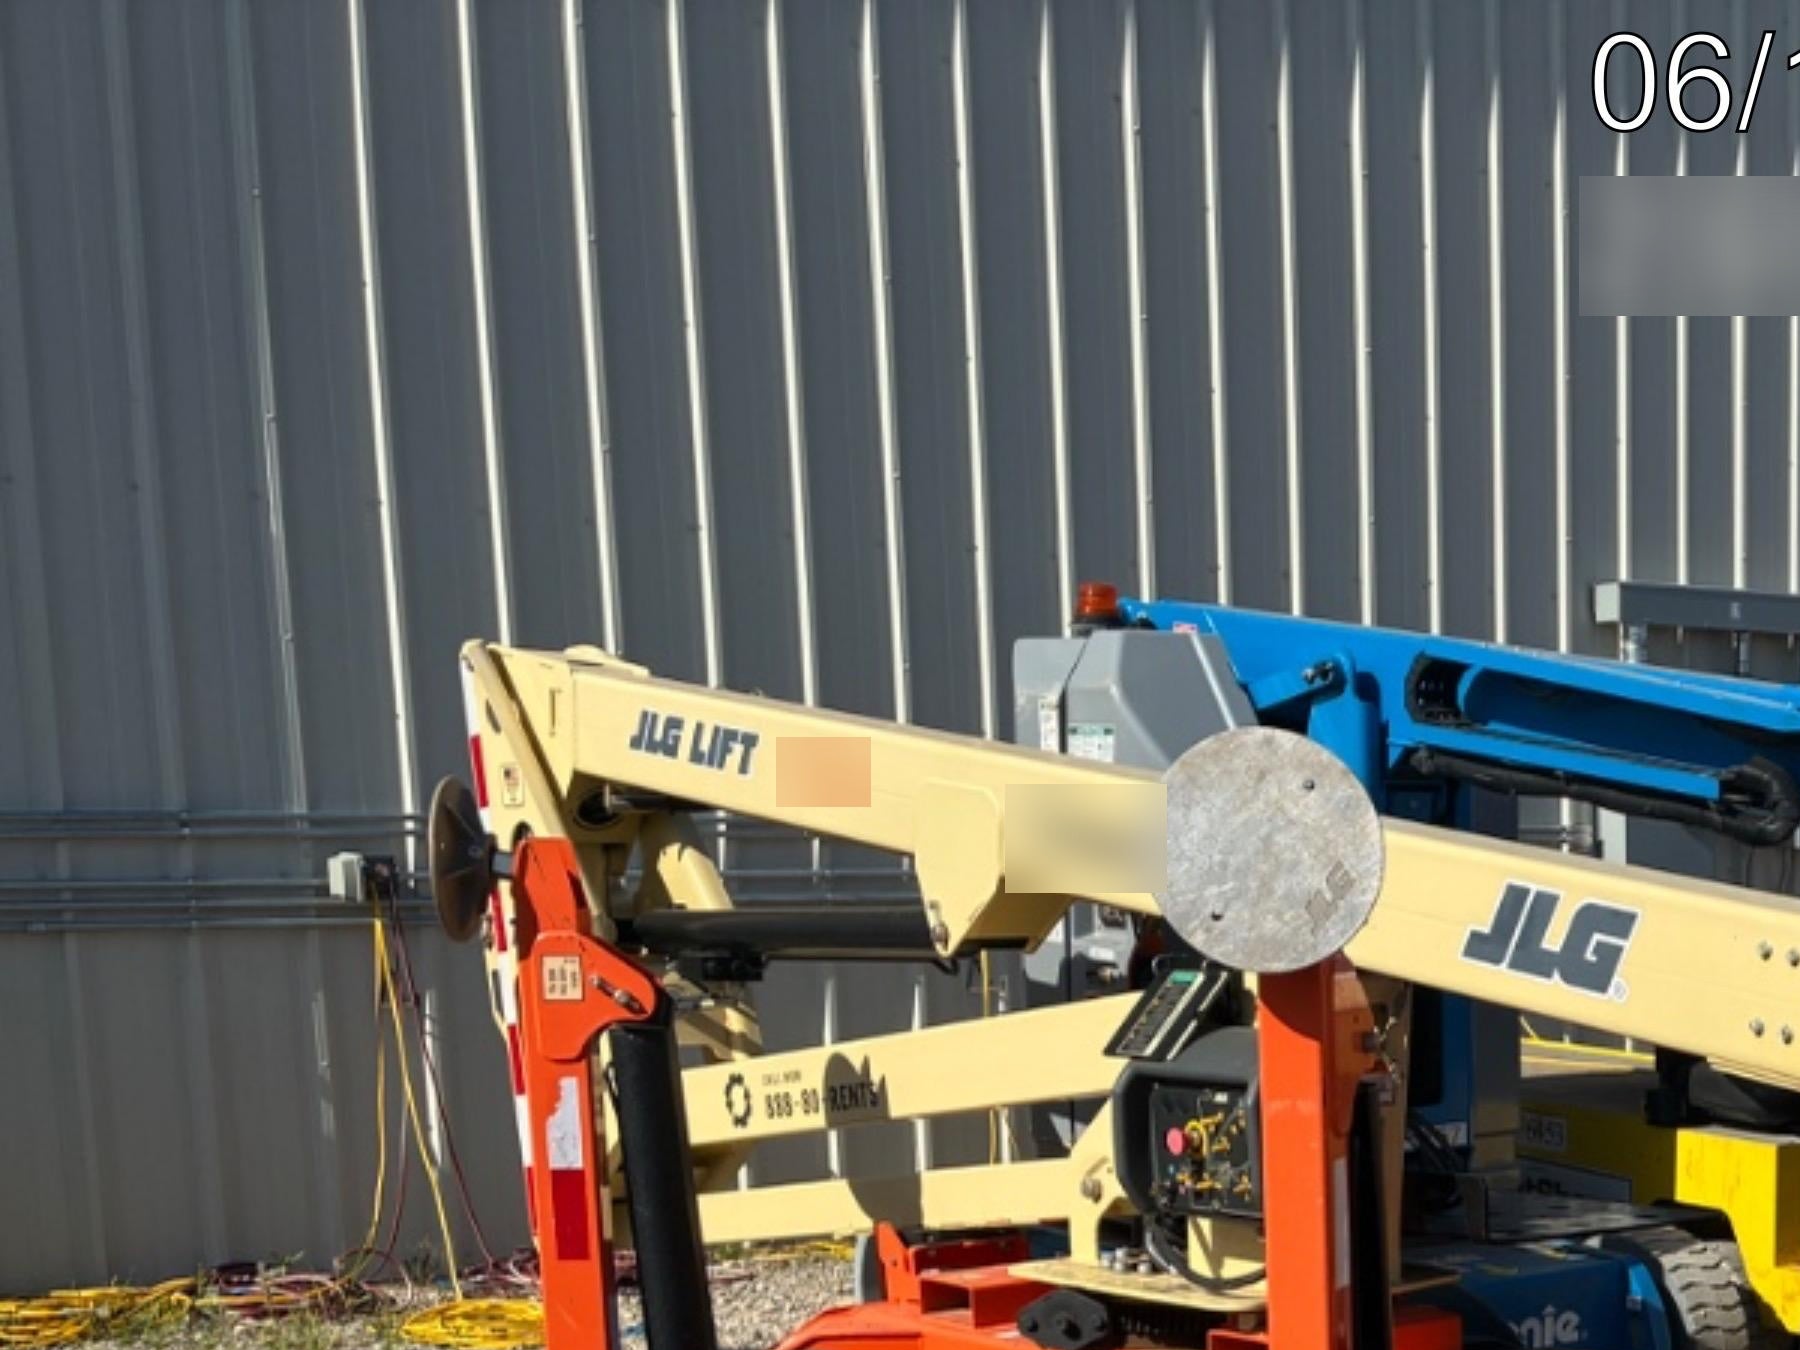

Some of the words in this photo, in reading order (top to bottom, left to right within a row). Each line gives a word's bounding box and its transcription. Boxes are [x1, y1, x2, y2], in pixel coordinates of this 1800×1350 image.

[630, 710, 684, 759] JLG
[689, 721, 760, 775] LIFT
[1460, 882, 1639, 996] JLG
